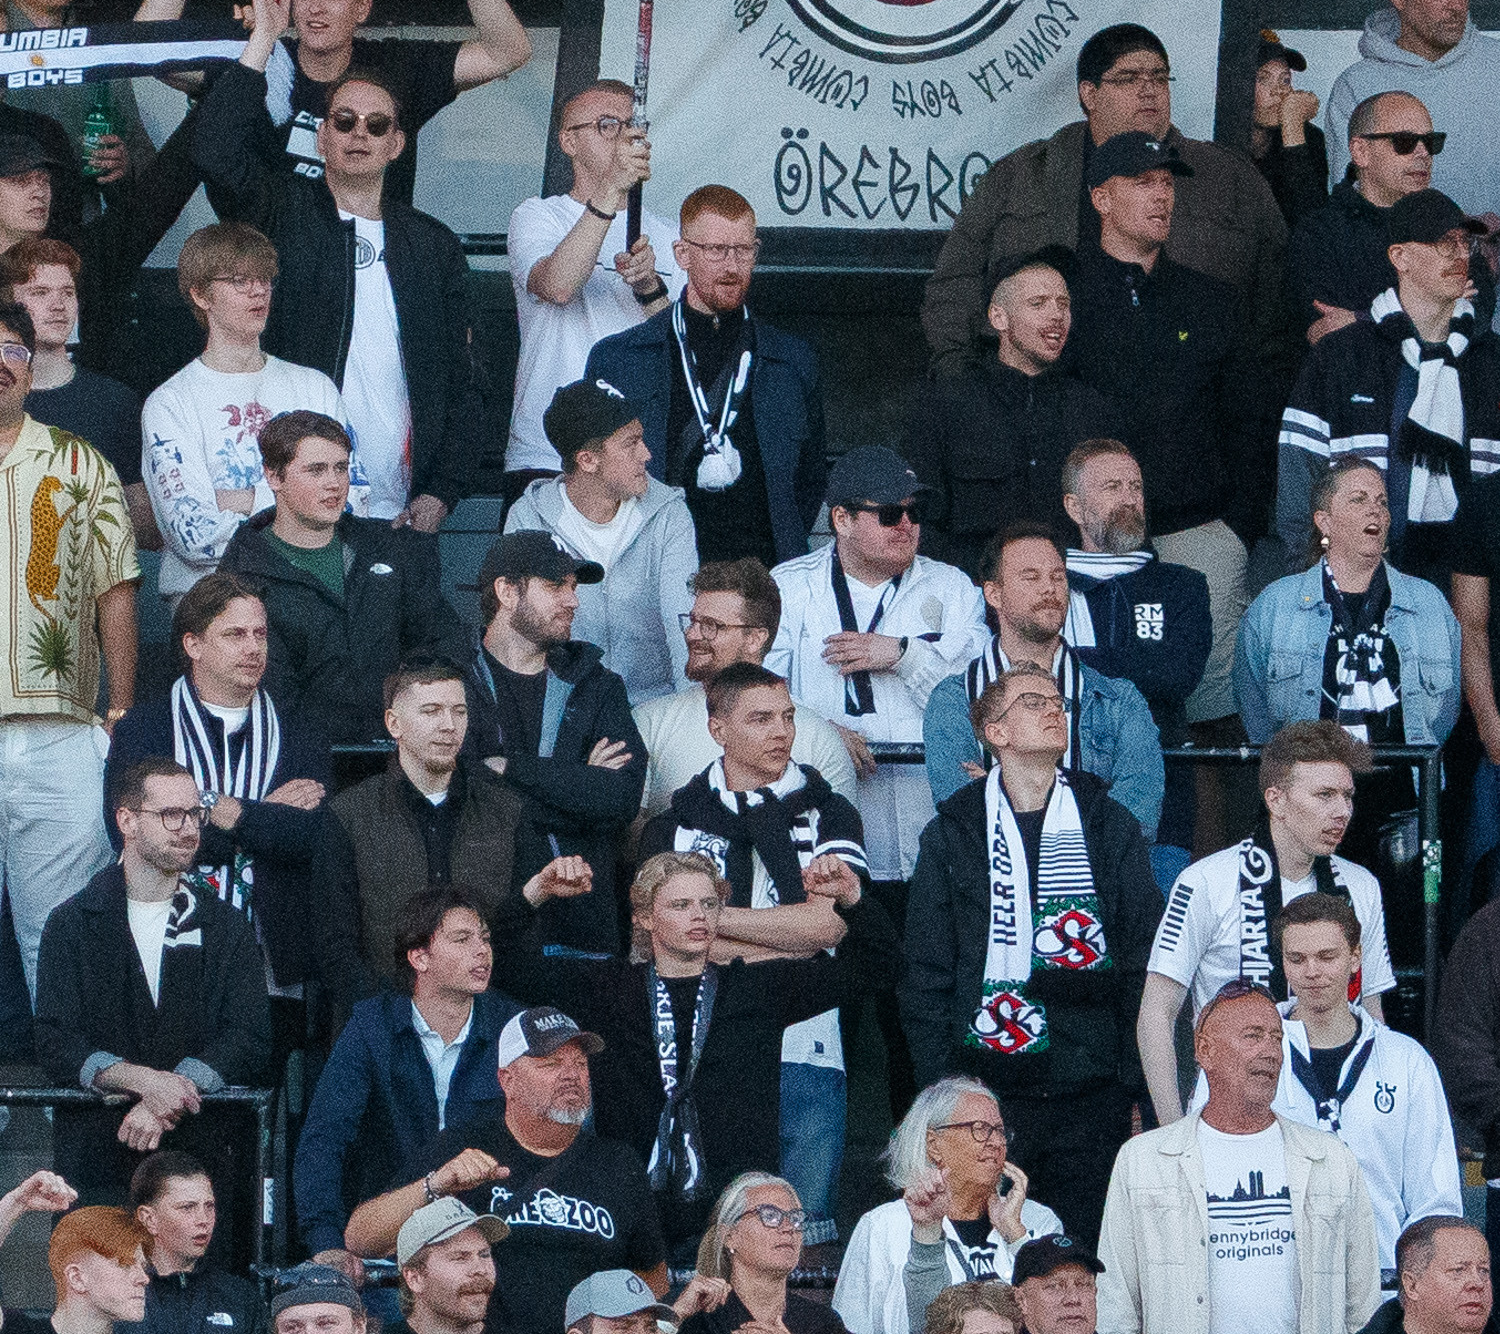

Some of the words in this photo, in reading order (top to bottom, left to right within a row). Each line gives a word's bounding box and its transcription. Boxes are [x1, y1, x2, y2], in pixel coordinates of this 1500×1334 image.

[8, 69, 83, 88] BOYS
[1134, 603, 1164, 621] RM
[1136, 622, 1163, 641] 83
[1208, 1227, 1297, 1246] ennybridge
[1216, 1244, 1285, 1261] originals
